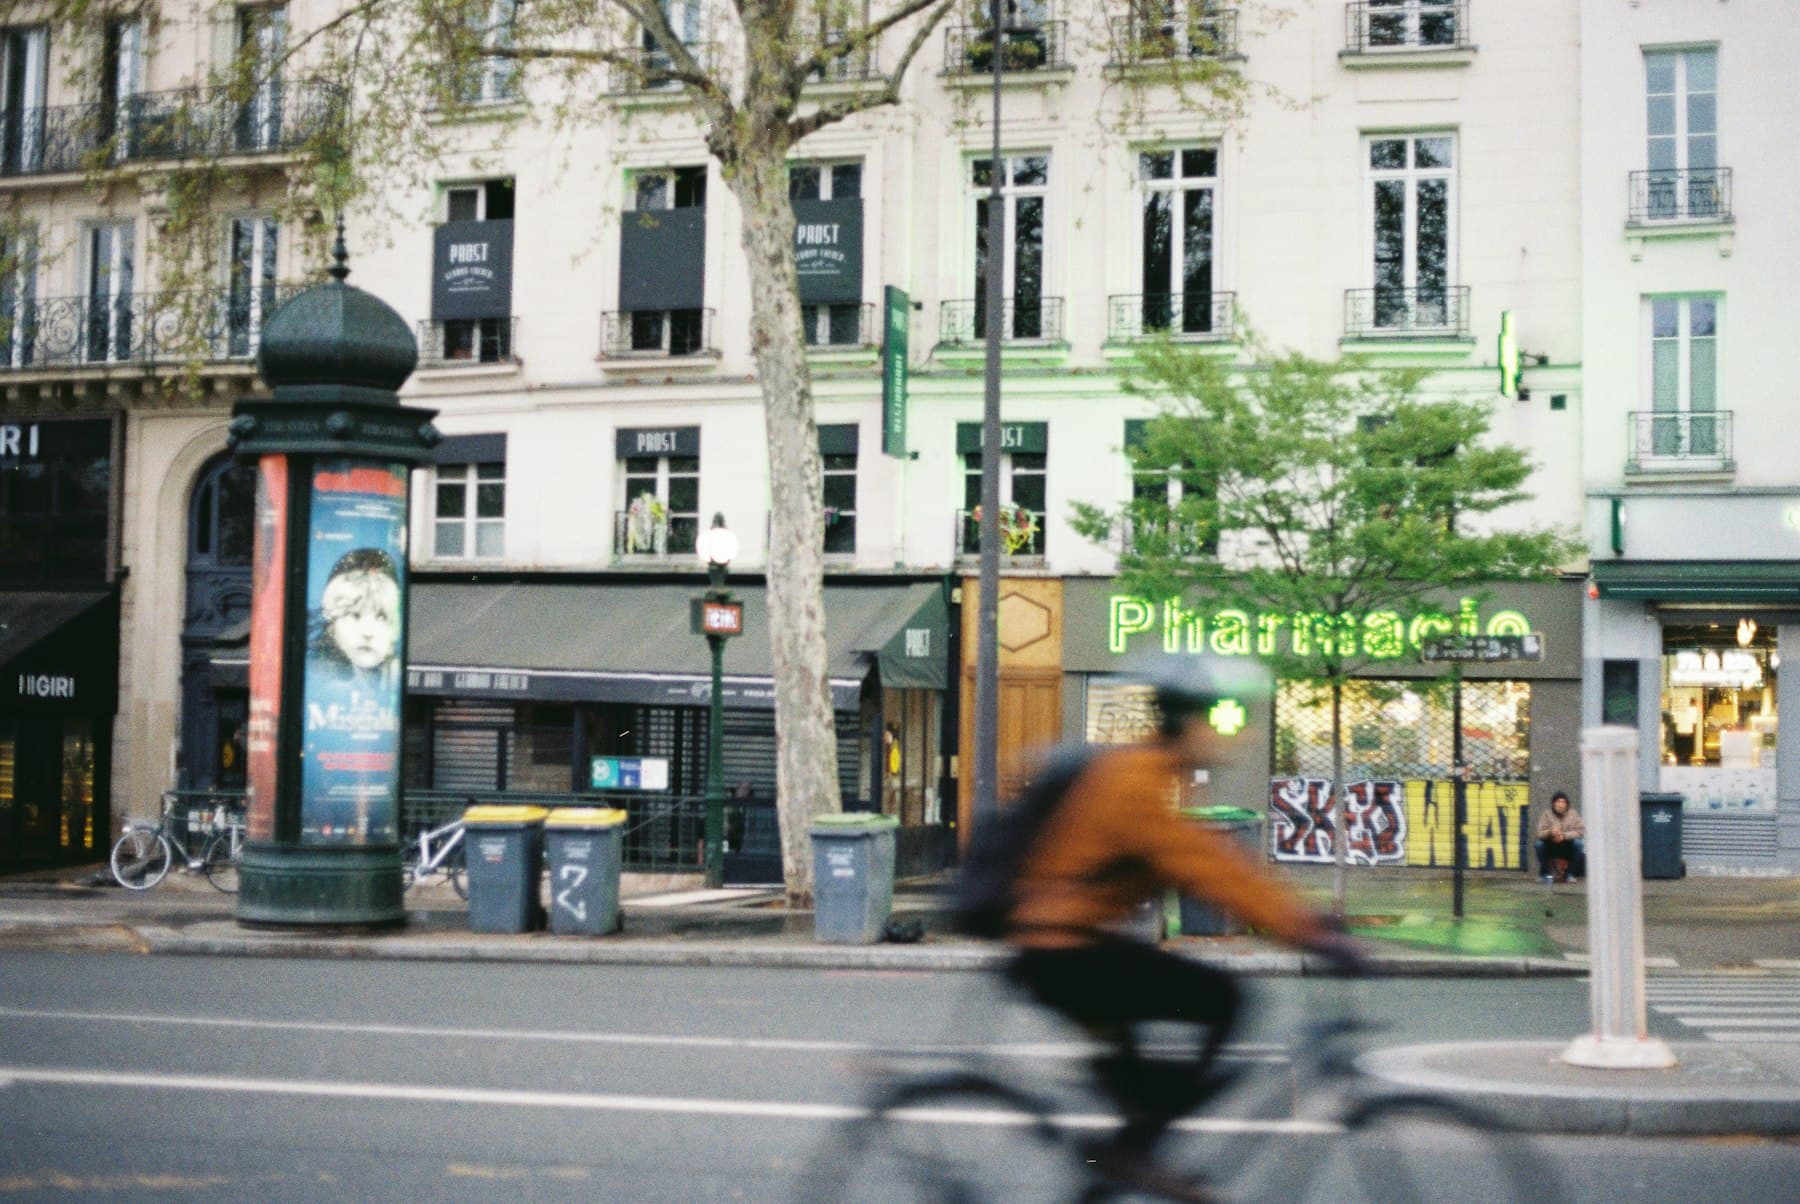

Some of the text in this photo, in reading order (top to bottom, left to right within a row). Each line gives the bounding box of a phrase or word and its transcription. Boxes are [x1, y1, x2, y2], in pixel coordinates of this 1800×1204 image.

[797, 224, 840, 245] PROST
[449, 243, 488, 263] PROST
[637, 432, 676, 452] PROST
